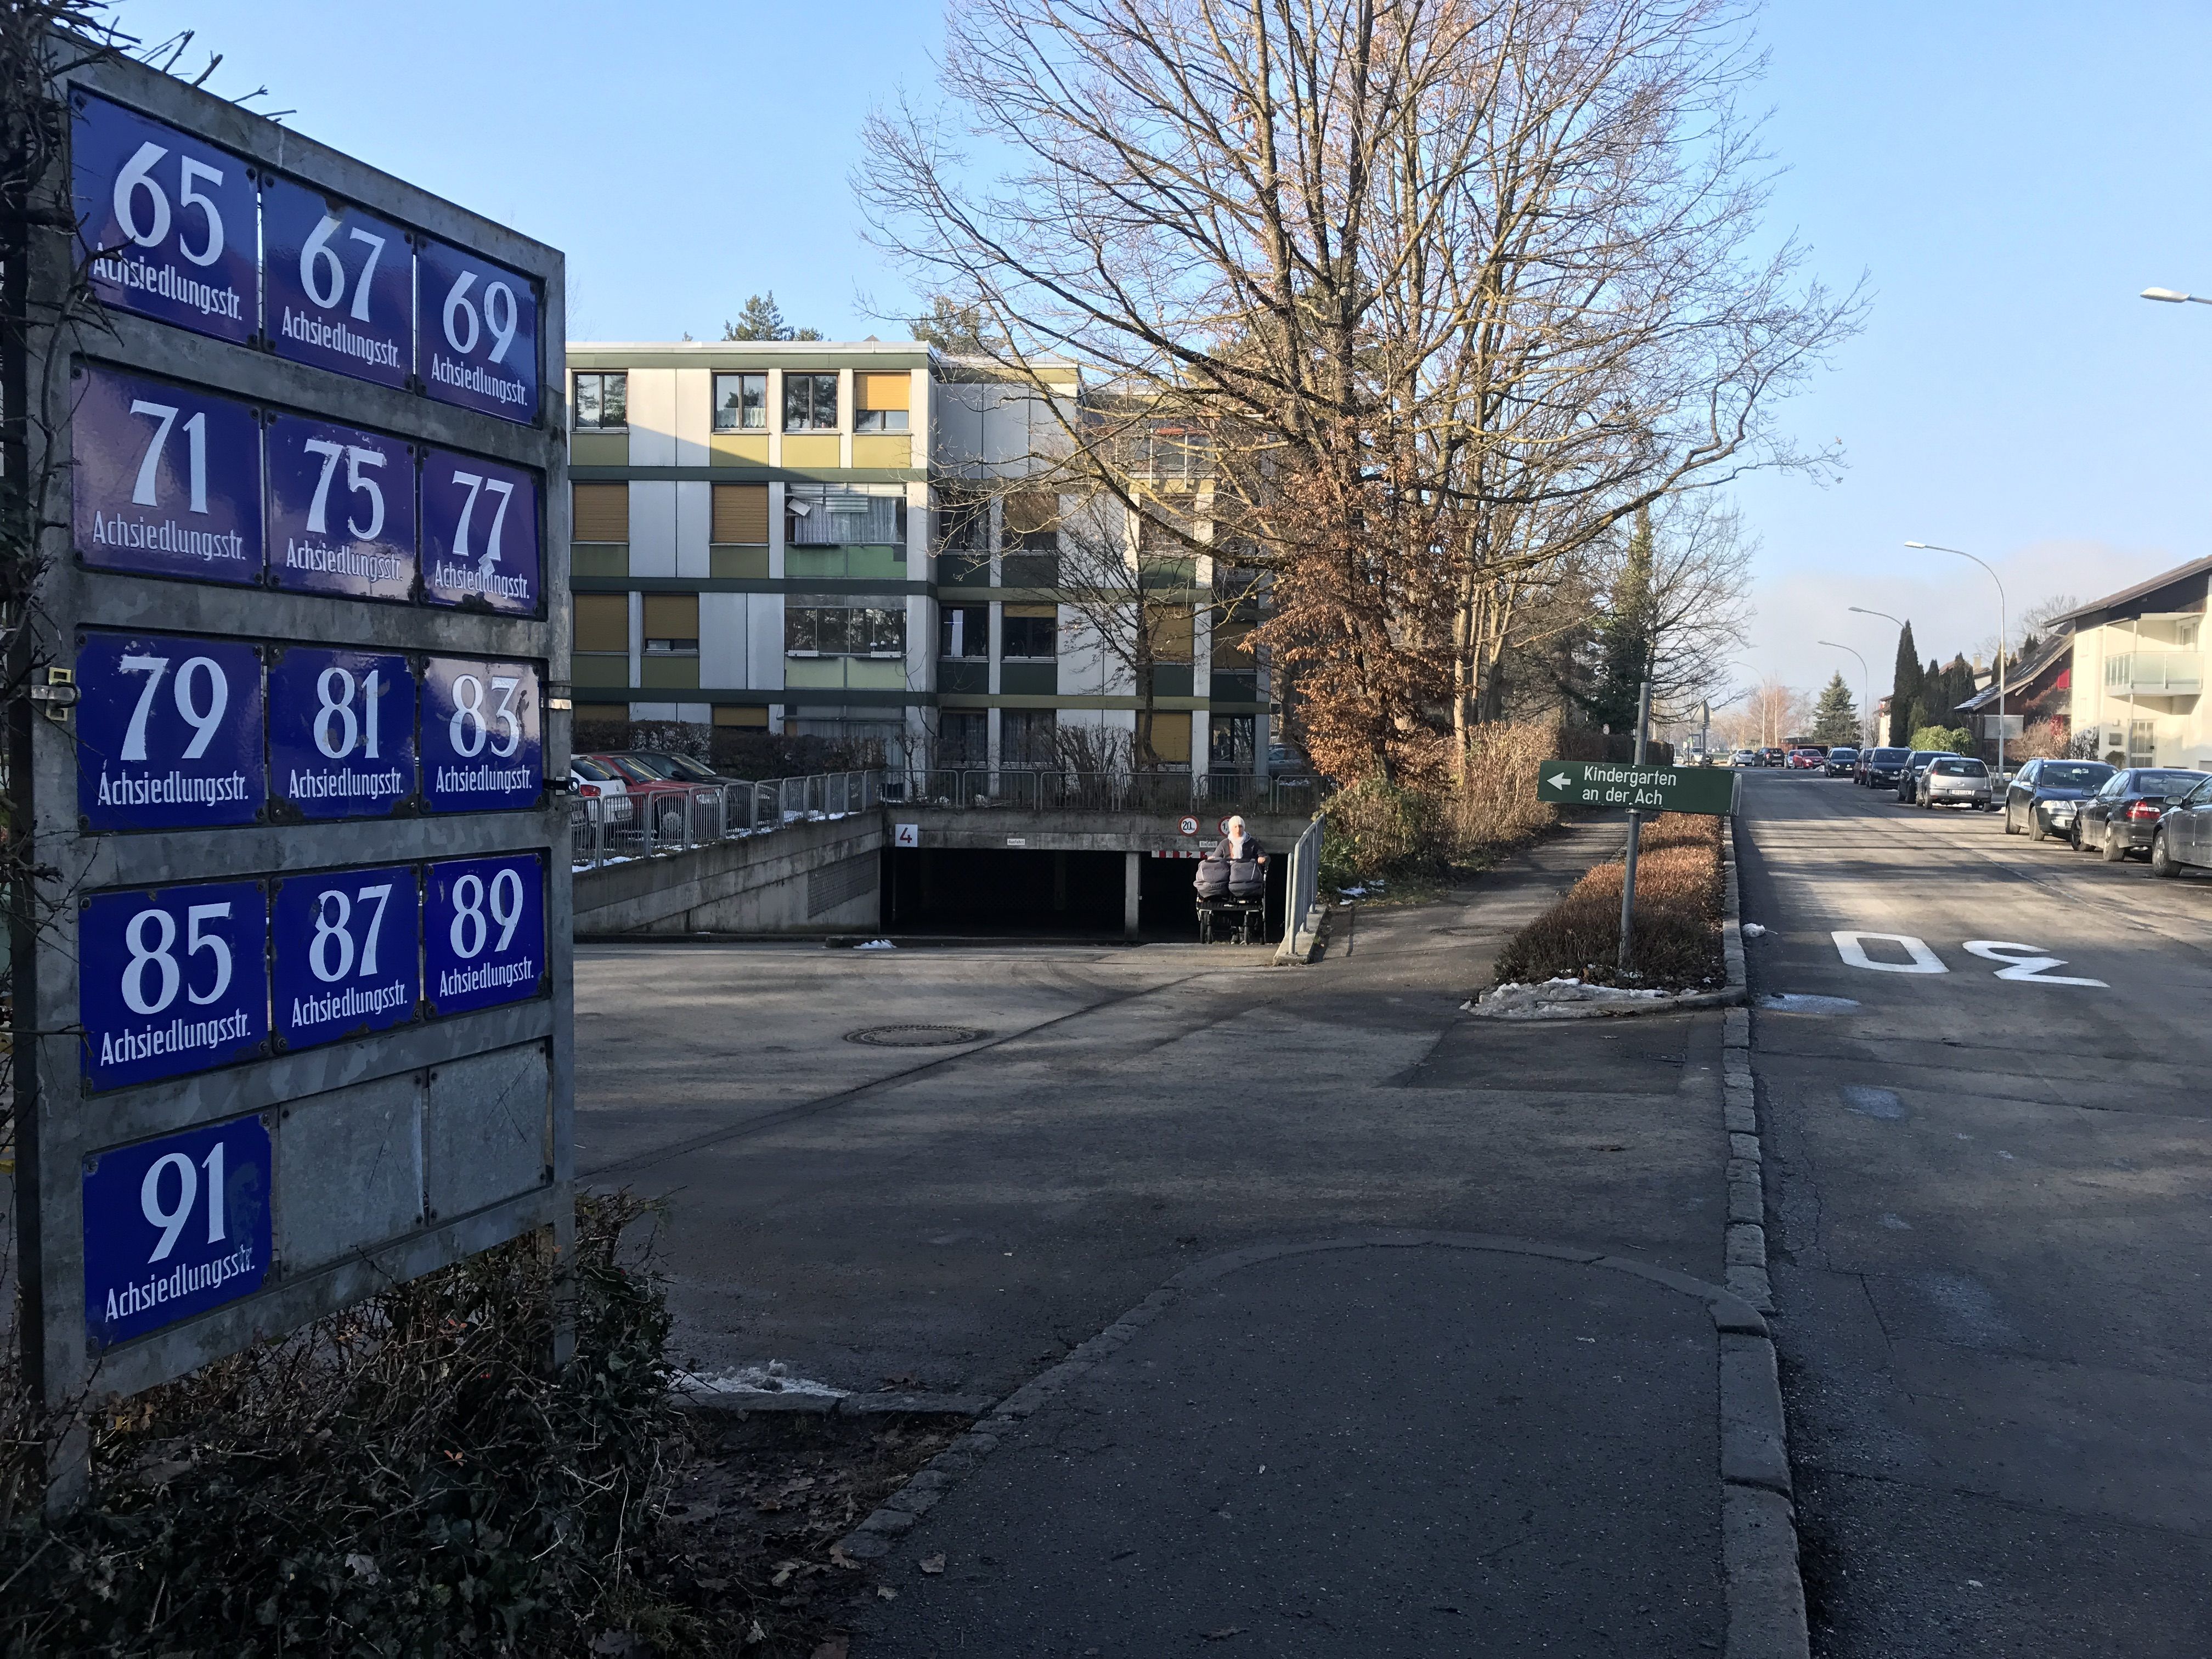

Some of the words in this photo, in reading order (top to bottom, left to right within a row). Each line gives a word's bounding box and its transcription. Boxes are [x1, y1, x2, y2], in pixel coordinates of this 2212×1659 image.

[114, 141, 223, 266] 65
[300, 216, 386, 322] 67
[282, 306, 400, 369] Achsiedlungsstr.
[443, 270, 517, 363] 69
[431, 354, 528, 406] Achsiedlungsstr.
[130, 399, 207, 514] 71
[304, 439, 385, 541] 75
[452, 470, 514, 561] 77
[93, 511, 246, 561] Achsiedlungsstr.
[286, 538, 403, 582] Achsiedlungsstr.
[435, 560, 530, 600] Achsiedlungsstr.
[119, 657, 228, 761] 79
[313, 667, 380, 759] 81
[449, 674, 521, 758] 83
[98, 770, 249, 806] Achsiedlungsstr.
[289, 766, 404, 800] Achsiedlungsstr.
[436, 765, 532, 794] Achsiedlungsstr.
[1582, 788, 1599, 800] an
[1605, 787, 1630, 803] der
[1634, 788, 1662, 805] Ach
[1584, 765, 1677, 787] Kindergarten
[900, 827, 912, 843] 4
[1182, 821, 1191, 831] 20
[309, 884, 393, 982] 87
[450, 868, 523, 958] 89
[121, 902, 231, 1014] 85
[439, 956, 534, 997] Achsiedlungsstr.
[1831, 931, 2111, 988] 30
[291, 979, 408, 1028] Achsiedlungsstr.
[100, 1008, 251, 1066] Achsiedlungsstr.
[140, 1142, 225, 1263] 91
[105, 1244, 255, 1322] Achsiedlungsstr.
